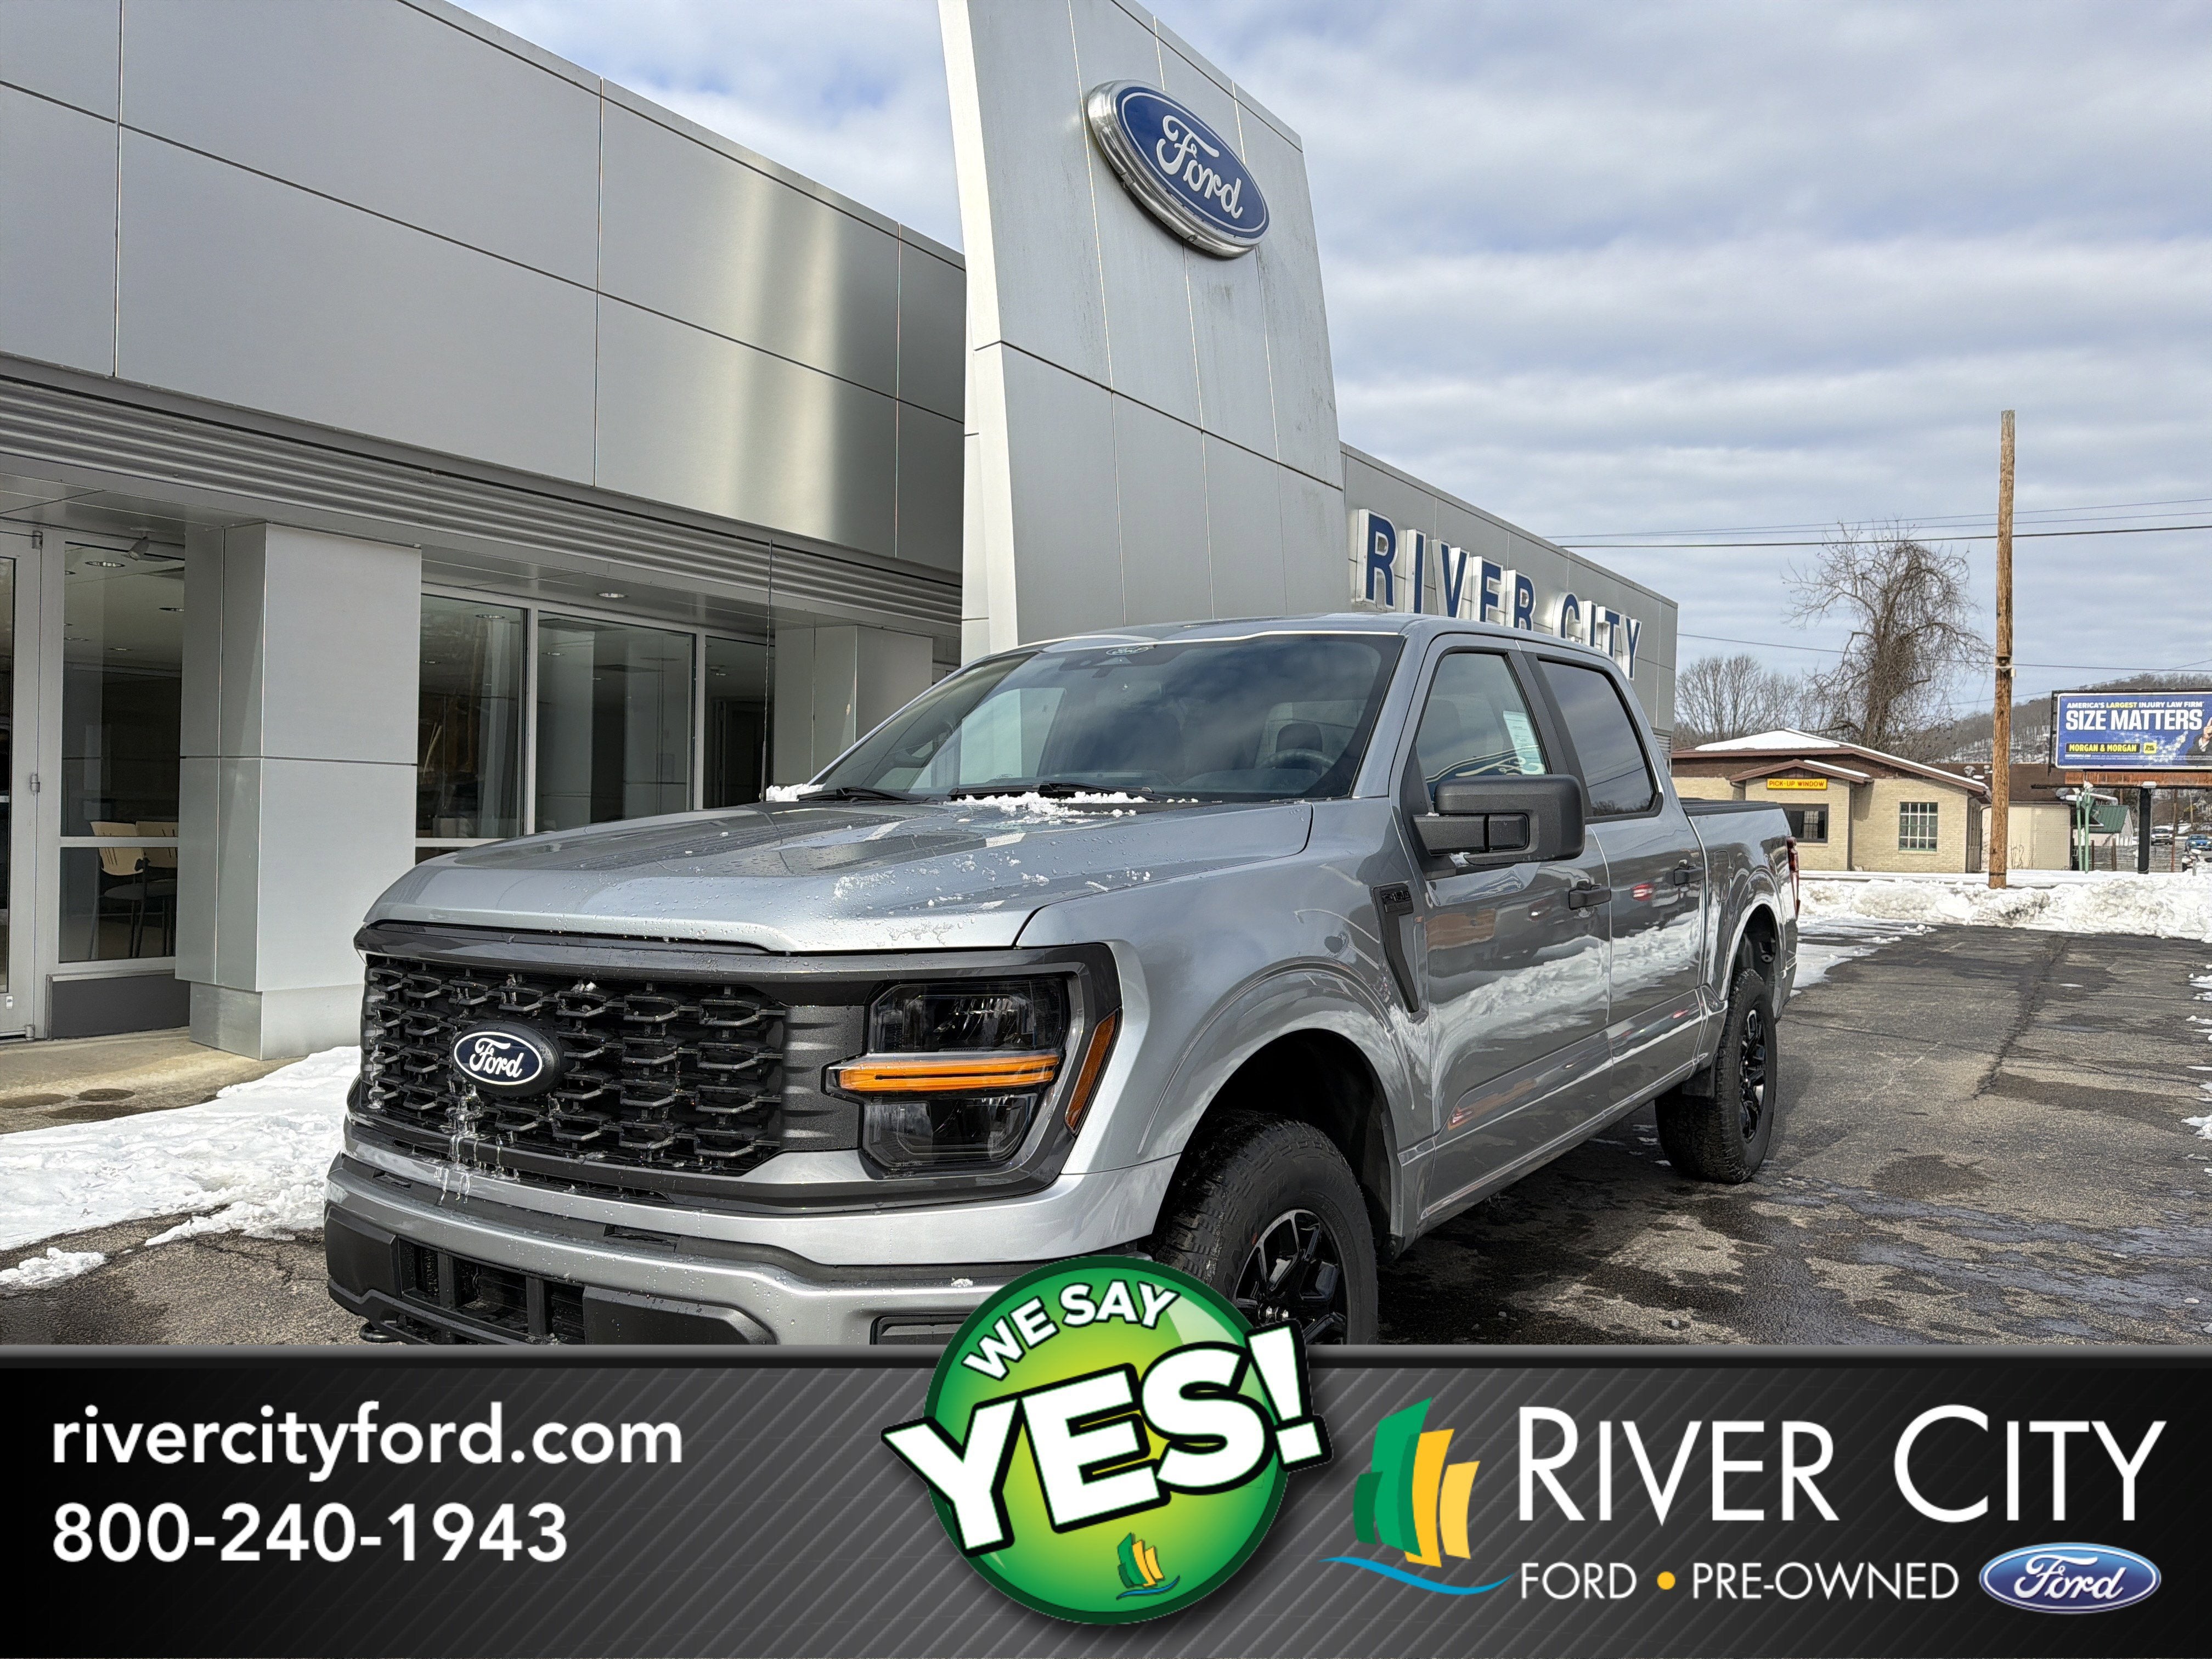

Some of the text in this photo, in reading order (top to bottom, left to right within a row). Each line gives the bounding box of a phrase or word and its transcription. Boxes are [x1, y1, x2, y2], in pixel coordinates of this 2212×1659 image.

[1155, 115, 1244, 219] Ford
[1355, 508, 1642, 681] RIVER CITY
[2066, 709, 2203, 731] SIZE MATTERS
[2069, 743, 2099, 752] MORGAN
[2100, 743, 2106, 752] &
[2106, 743, 2137, 752] MORGAN
[469, 1037, 524, 1078] Ford
